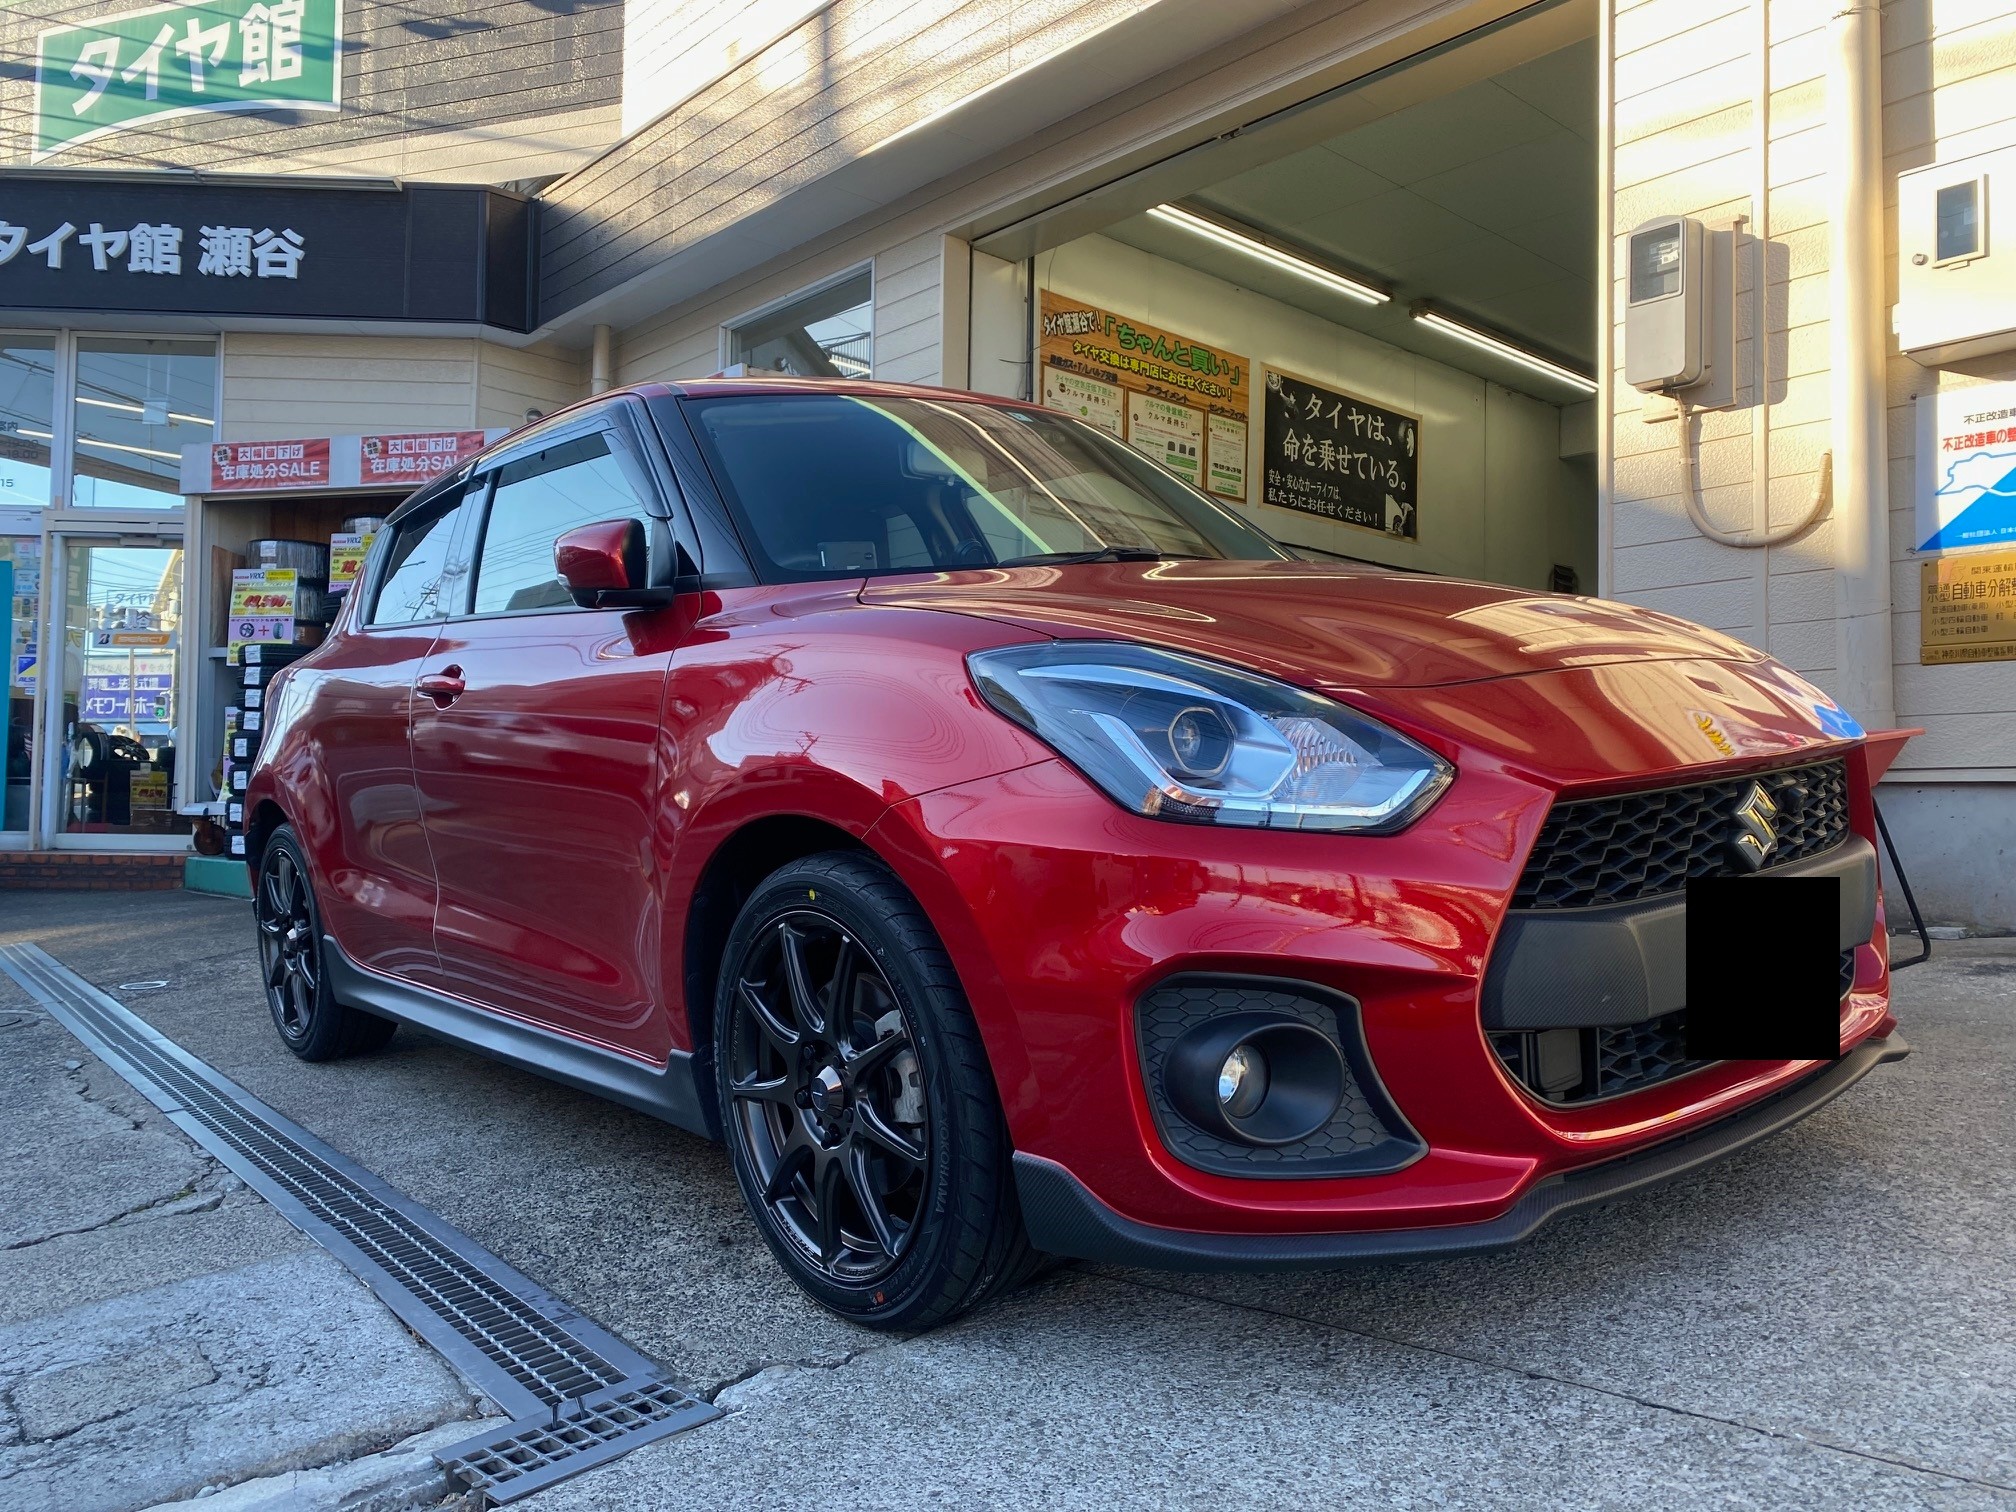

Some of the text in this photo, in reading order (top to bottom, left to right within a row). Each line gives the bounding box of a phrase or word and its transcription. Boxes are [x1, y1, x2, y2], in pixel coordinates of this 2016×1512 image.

[70, 0, 304, 116] タイヤ館
[197, 225, 305, 279] 瀬谷
[1043, 310, 1101, 336] タイヤ館瀬谷で！
[1104, 315, 1240, 385] 「ちゃんと買い」
[1073, 340, 1232, 398] タイヤ交換は専門店にお任せください！
[1146, 383, 1190, 404] アライメント
[1305, 393, 1393, 445] タイヤは、
[239, 446, 302, 460] 大幅値下げ
[390, 439, 455, 452] 大幅値下げ
[1283, 428, 1406, 490] 命を乗せている。
[221, 461, 320, 480] 在庫処分SALE
[1268, 469, 1342, 501] 安全・安心なカーライフは、
[1268, 487, 1378, 526] 私たちにお任せください！
[2001, 527, 2016, 535] 日本
[1971, 563, 2016, 575] 関東運輸
[1932, 626, 1989, 637] 小型三輪自動車
[936, 1117, 951, 1213] YOKOHAMA
